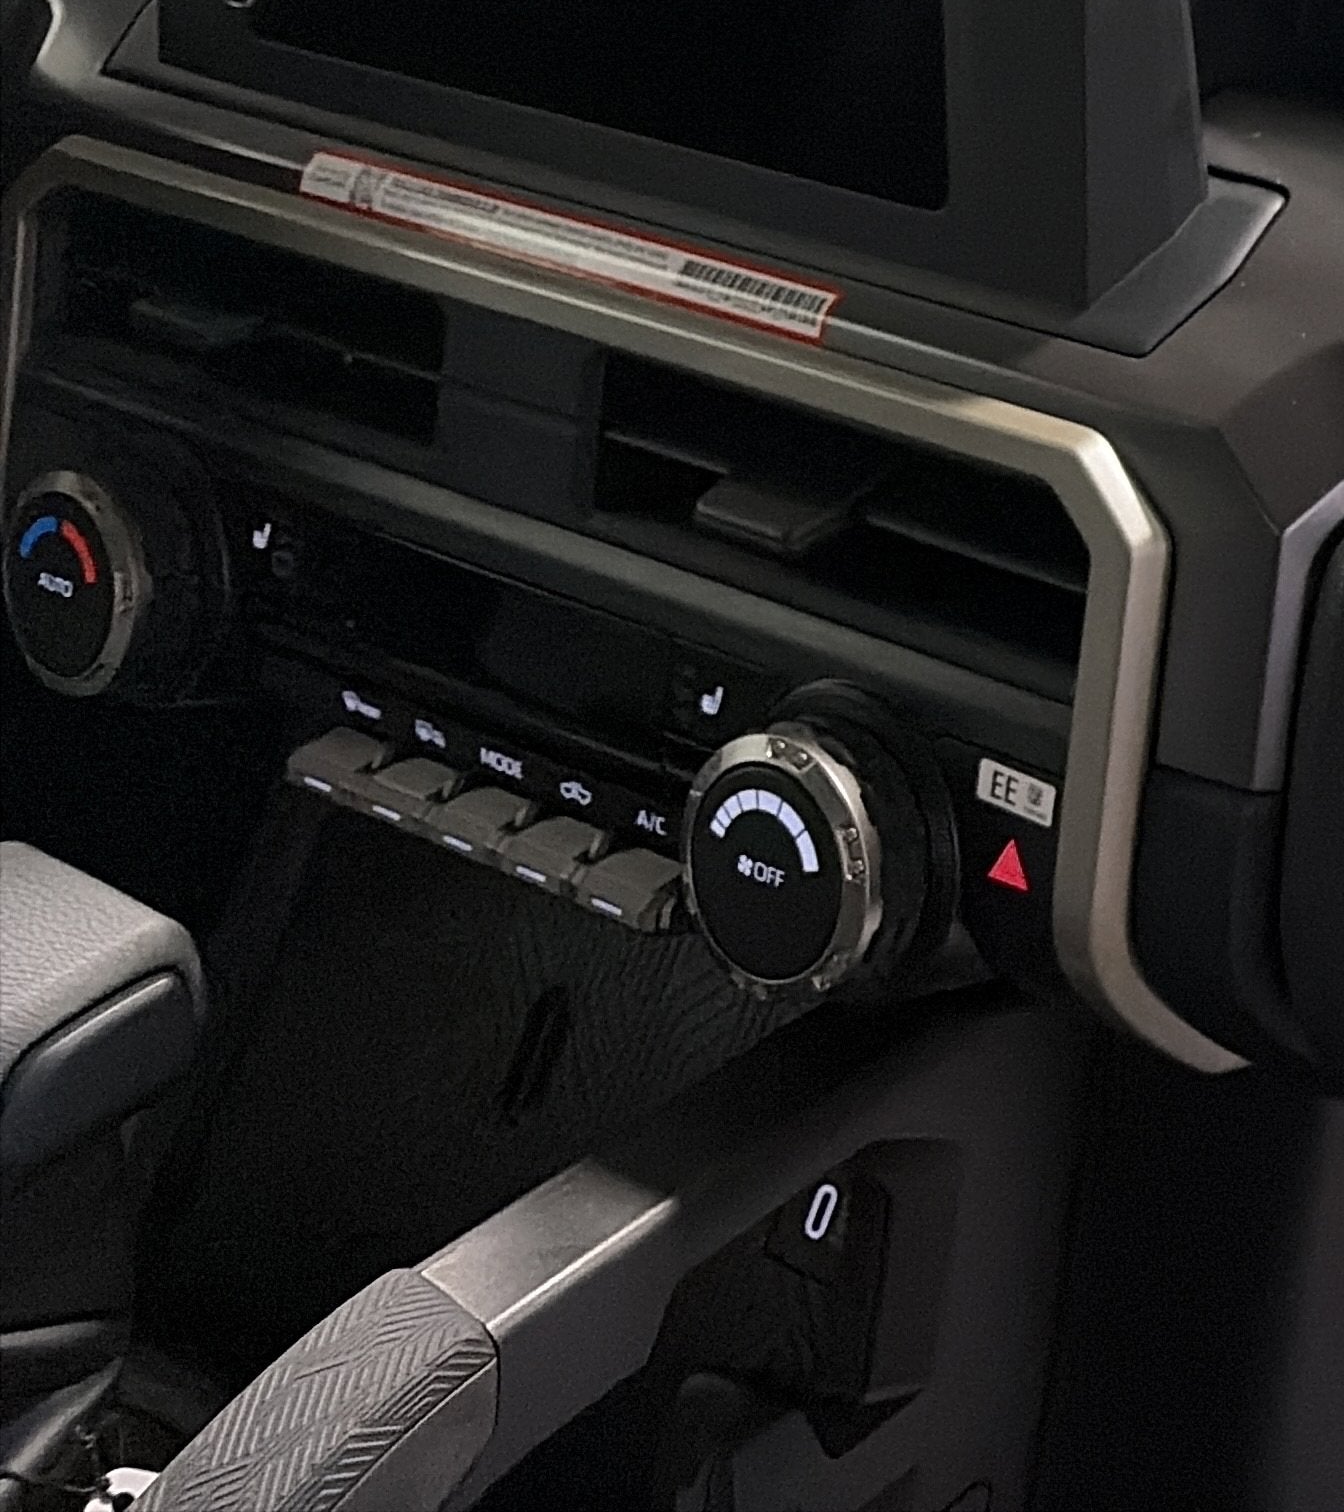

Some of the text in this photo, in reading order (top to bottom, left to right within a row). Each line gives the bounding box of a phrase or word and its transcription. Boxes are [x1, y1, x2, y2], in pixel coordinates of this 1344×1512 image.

[480, 747, 523, 780] MODE
[990, 770, 1020, 807] EE
[634, 808, 668, 836] A/C
[752, 861, 785, 888] OFF
